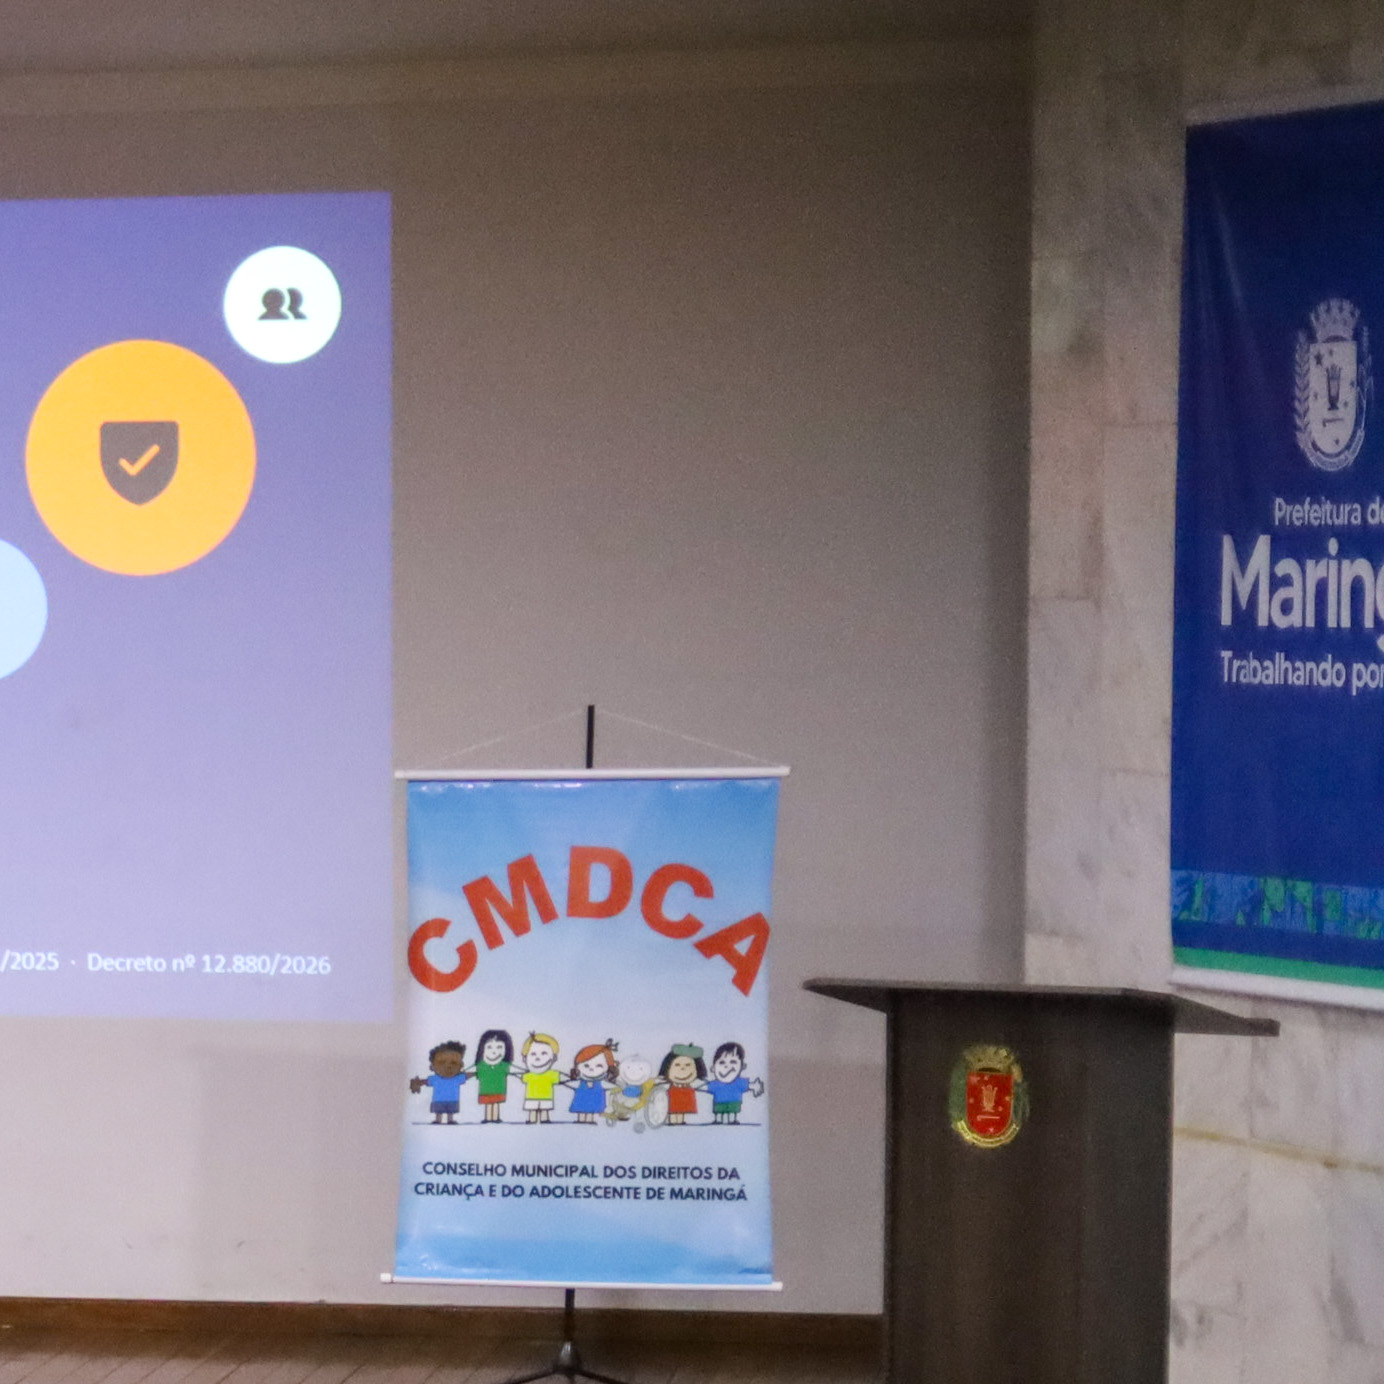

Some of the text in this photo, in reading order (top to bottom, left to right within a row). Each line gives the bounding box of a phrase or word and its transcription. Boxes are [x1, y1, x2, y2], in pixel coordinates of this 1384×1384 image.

[1274, 496, 1362, 526] Prefeitura
[1221, 534, 1384, 654] Marin
[1221, 650, 1346, 687] Trabalhando
[407, 846, 770, 996] CMDCA
[87, 952, 167, 972] Decreto
[202, 953, 332, 976] 12.880/2026
[422, 1161, 741, 1181] CONSELHO MUNICIPAL DOS DIREITOS DA
[413, 1182, 748, 1202] CRIANÇA E DO ADOLESCENTE DE MARINGÁ
